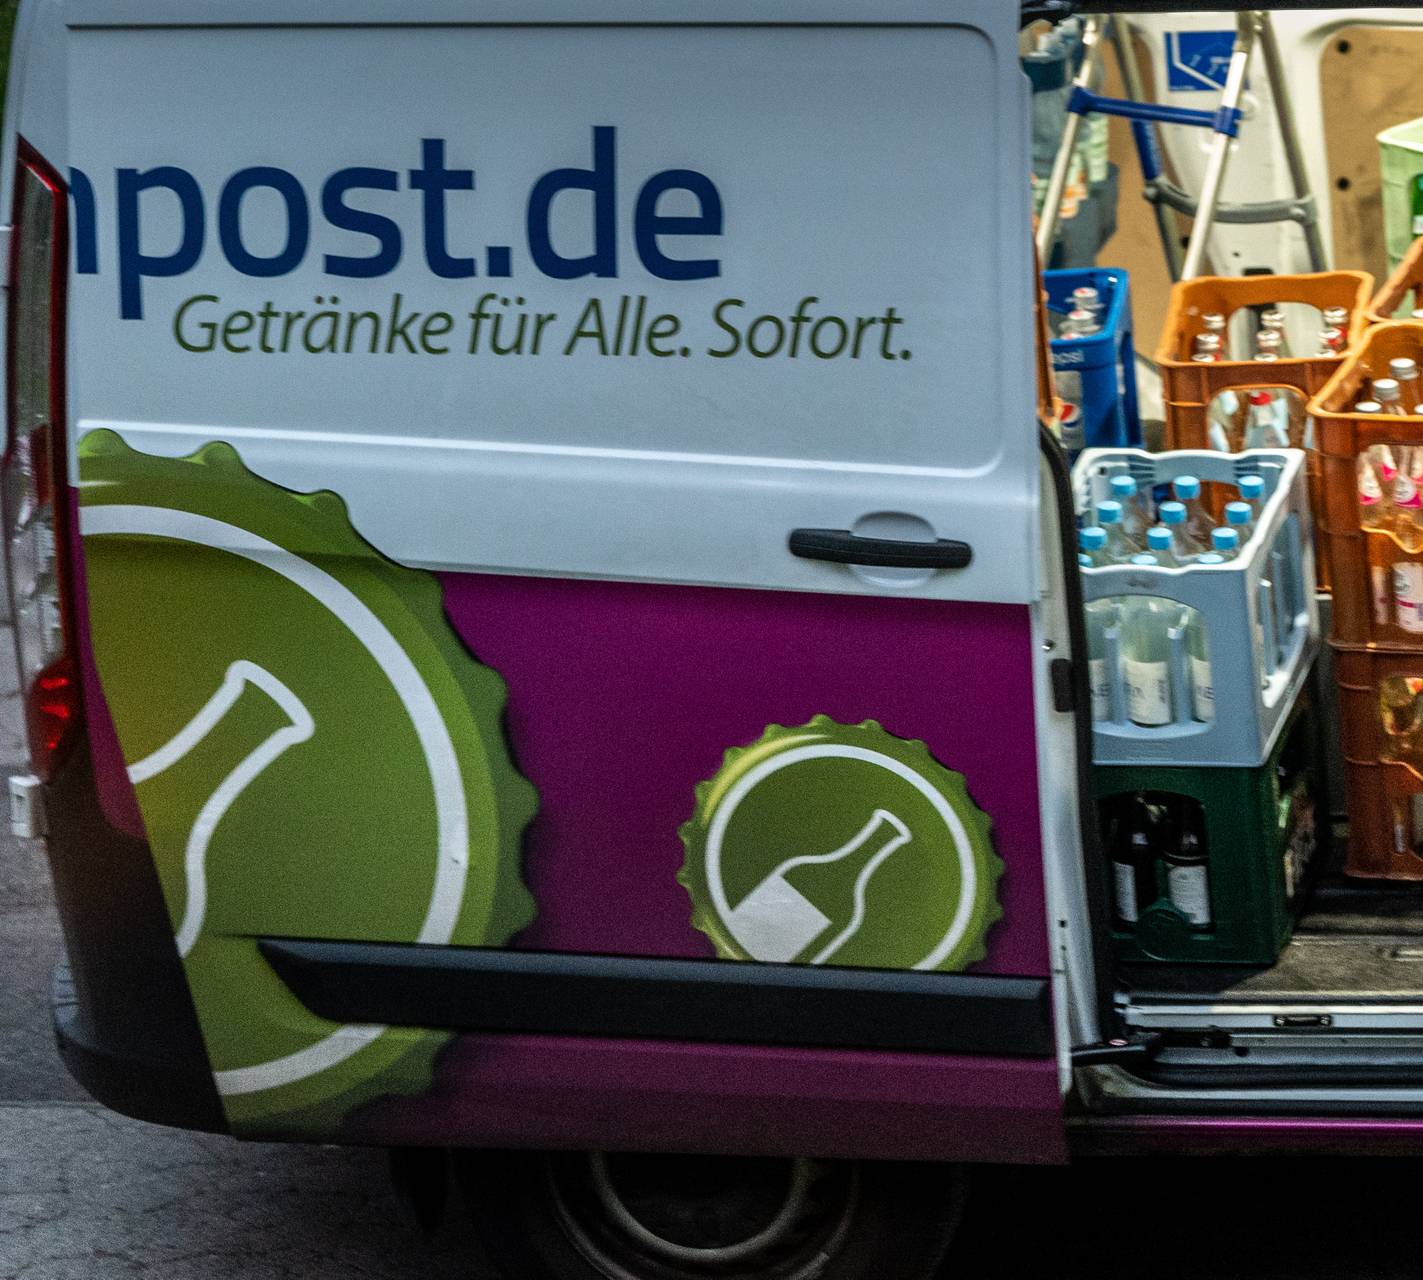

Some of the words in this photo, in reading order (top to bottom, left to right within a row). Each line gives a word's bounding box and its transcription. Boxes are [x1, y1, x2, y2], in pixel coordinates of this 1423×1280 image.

[172, 293, 455, 356] Getränke
[468, 293, 557, 357] für
[563, 295, 692, 358] Alle.
[707, 296, 913, 361] Sofort.
